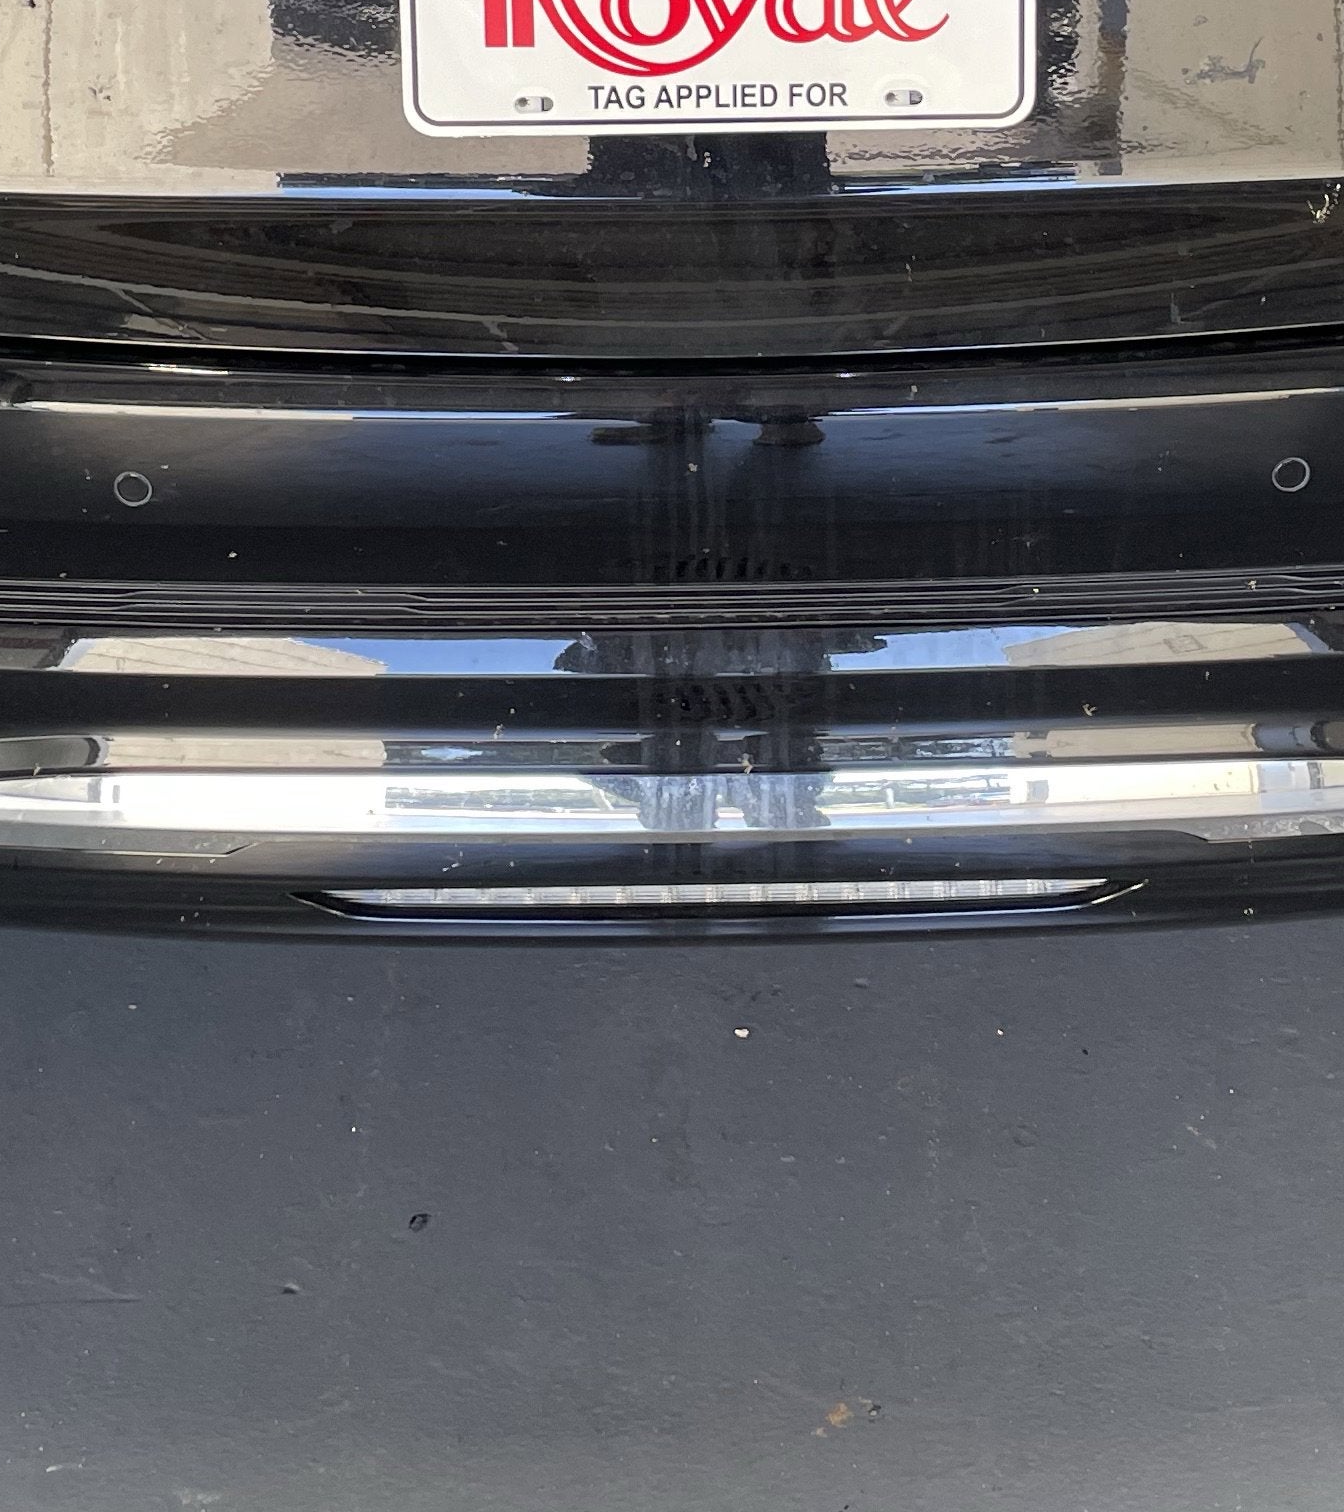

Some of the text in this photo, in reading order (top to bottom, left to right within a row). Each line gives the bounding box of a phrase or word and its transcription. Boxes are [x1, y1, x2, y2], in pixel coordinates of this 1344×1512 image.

[587, 83, 849, 110] TAG APPLIED FOR
